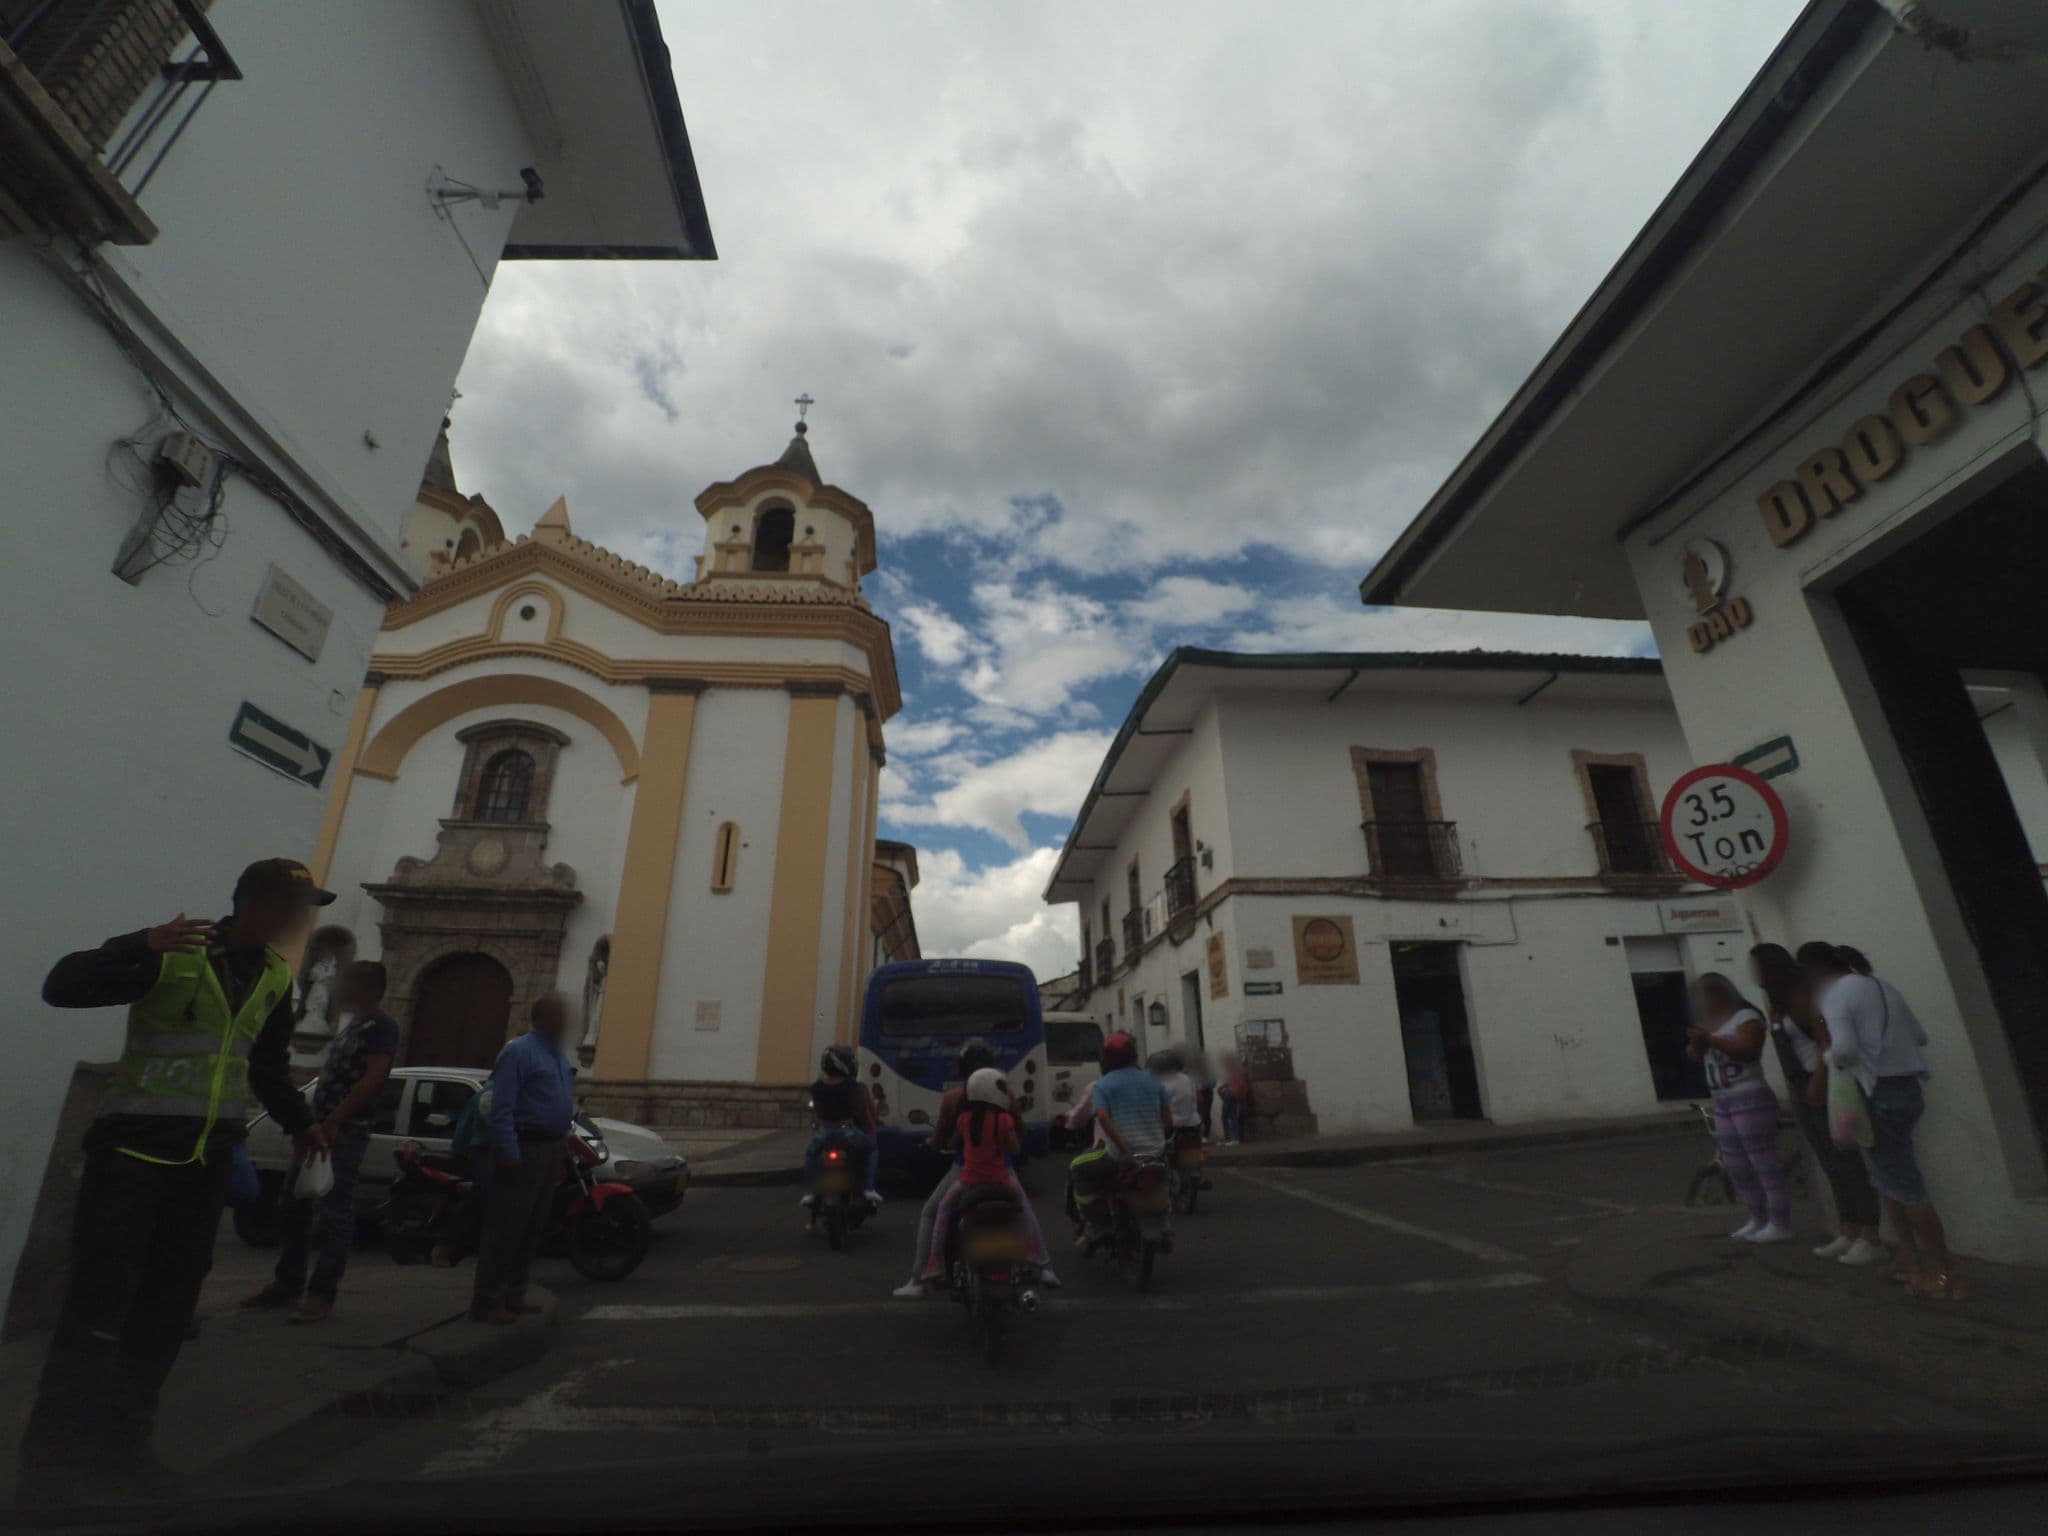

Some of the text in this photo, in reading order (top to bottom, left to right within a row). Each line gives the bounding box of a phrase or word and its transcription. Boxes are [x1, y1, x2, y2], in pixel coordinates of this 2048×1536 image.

[1757, 267, 2048, 548] DROGUE
[1685, 784, 1735, 827] 3.5
[1685, 829, 1765, 866] Ton
